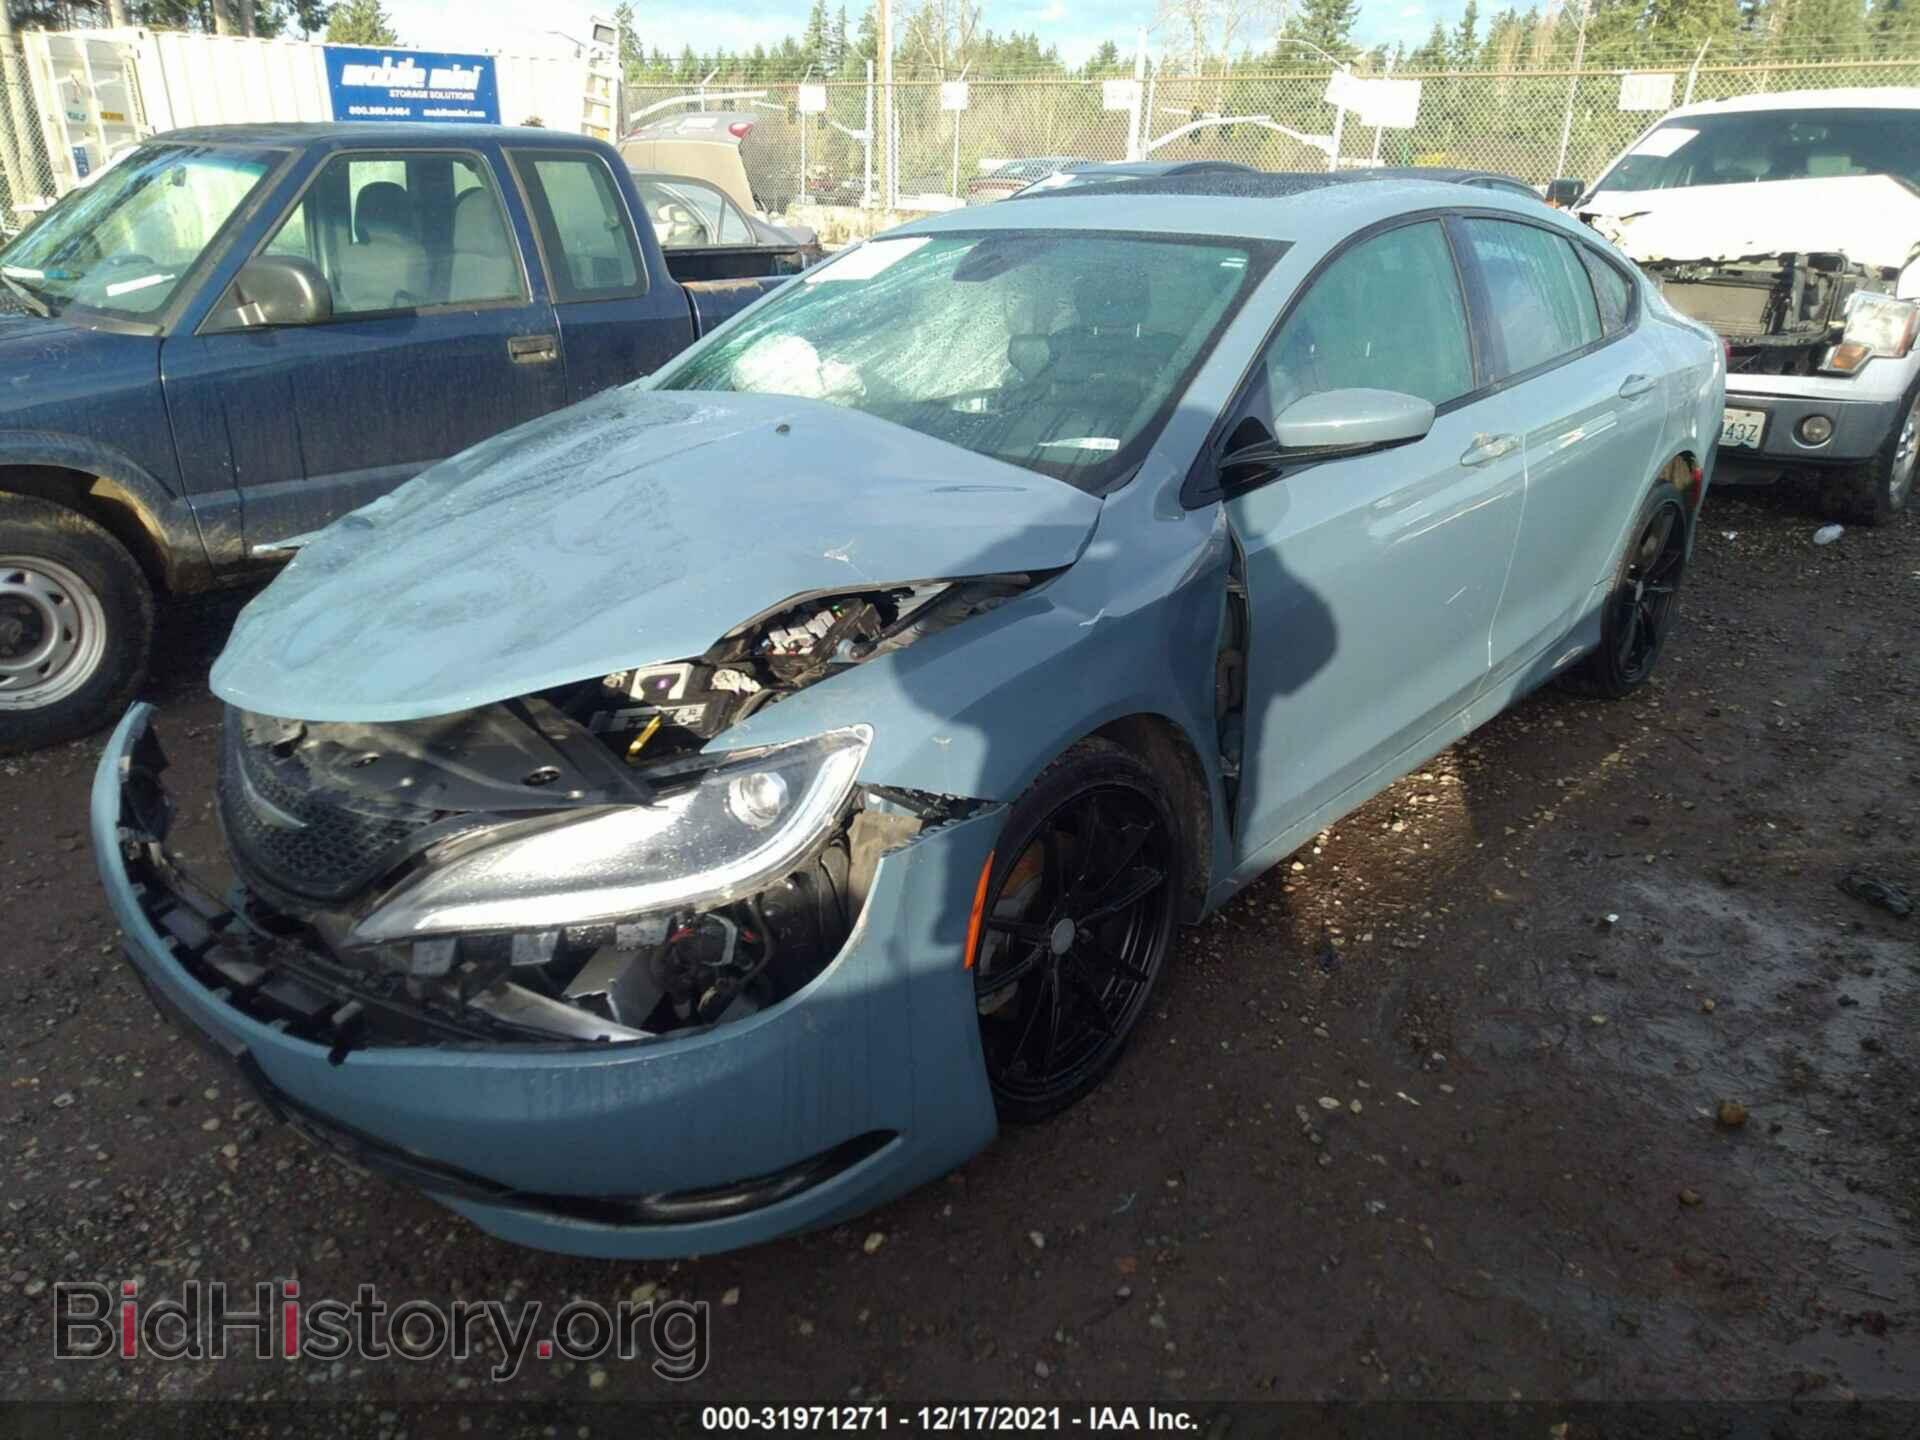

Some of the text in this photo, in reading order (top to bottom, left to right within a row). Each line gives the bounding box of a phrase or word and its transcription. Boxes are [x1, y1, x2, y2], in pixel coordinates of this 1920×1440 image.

[342, 57, 479, 90] mobile mini
[389, 89, 475, 101] STORAGE SOLUTIONS
